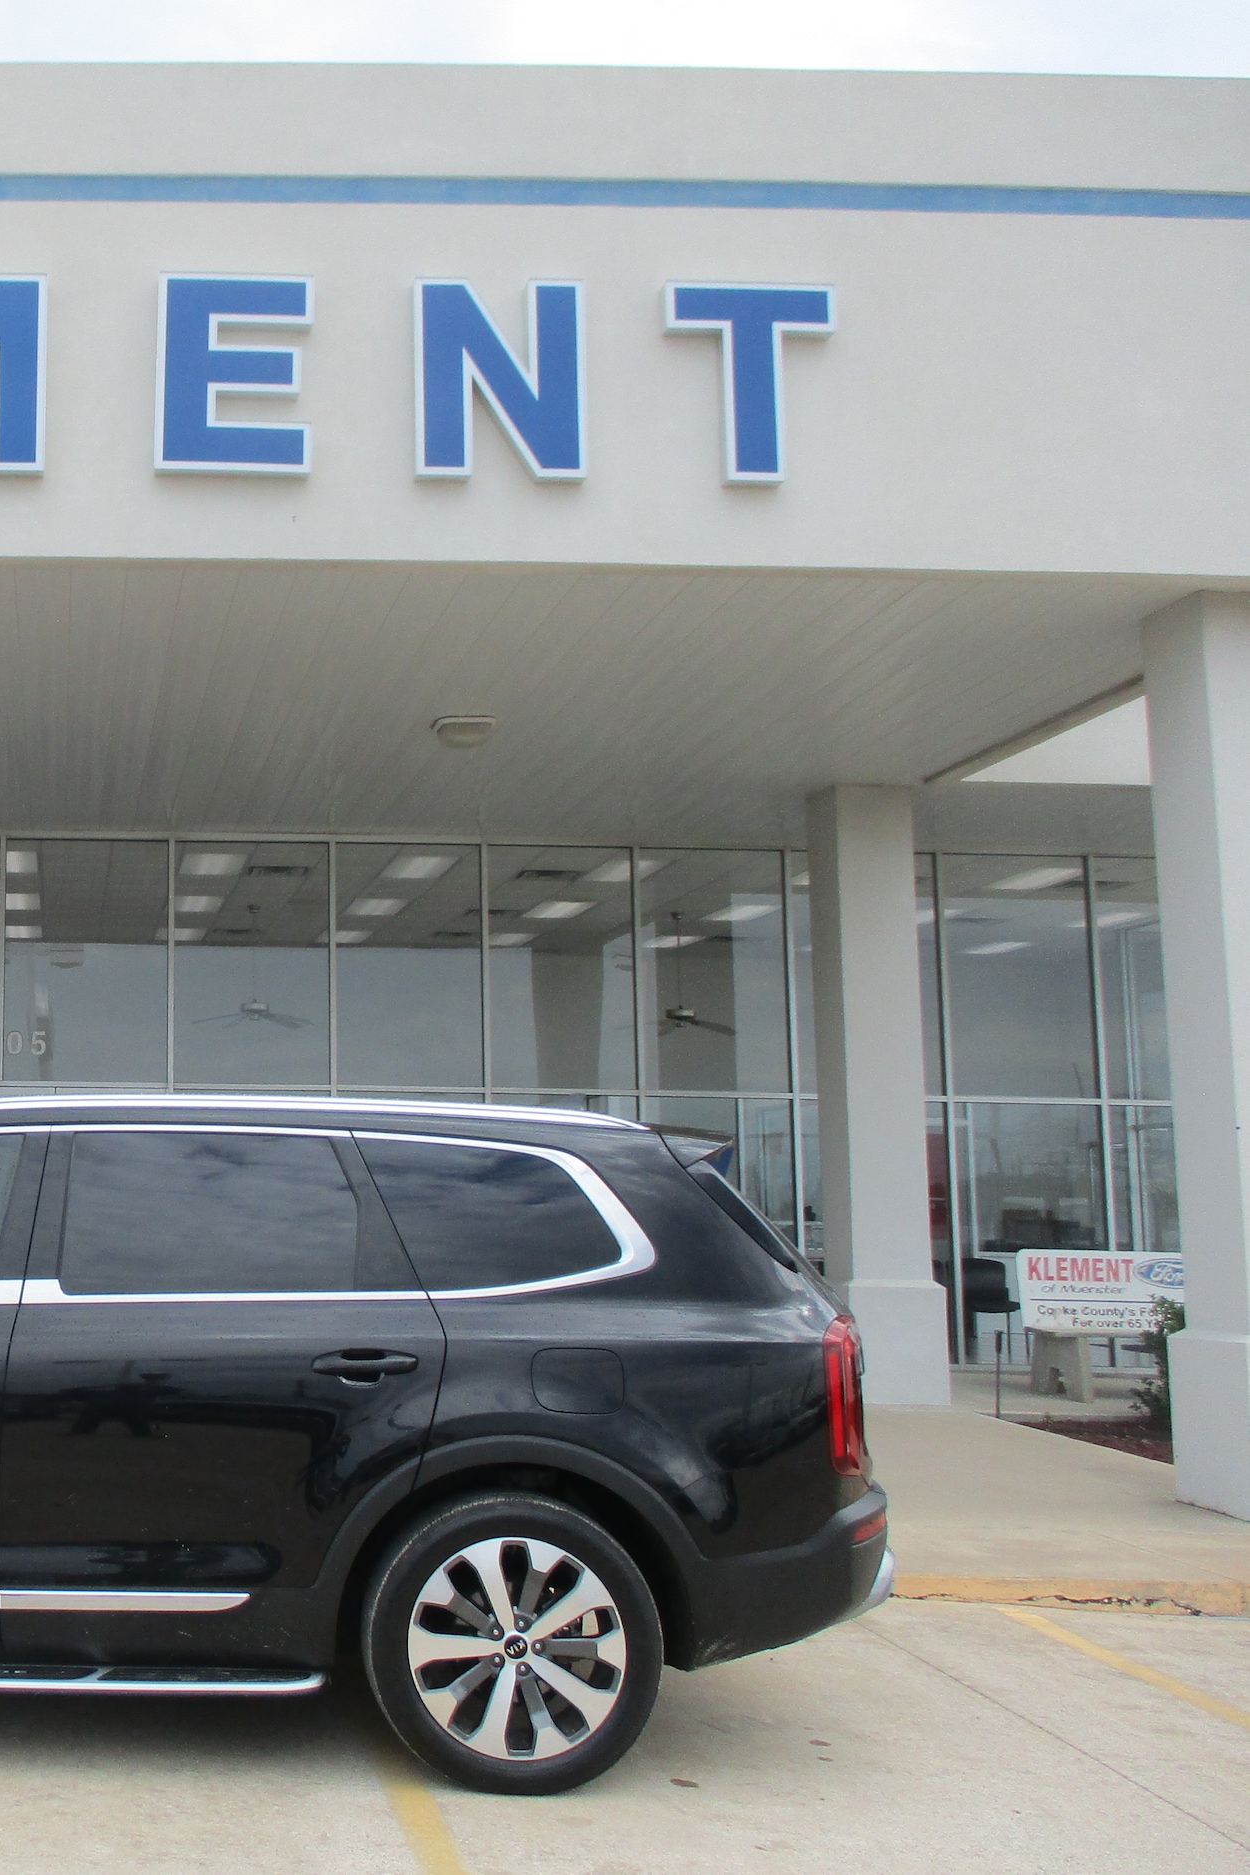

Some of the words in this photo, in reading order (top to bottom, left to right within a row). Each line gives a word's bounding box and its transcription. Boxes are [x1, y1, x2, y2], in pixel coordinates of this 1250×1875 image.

[1027, 1257, 1134, 1283] KLEMENT
[1150, 1262, 1182, 1285] For
[1041, 1284, 1056, 1293] of
[1060, 1285, 1126, 1294] Muenster
[1037, 1304, 1078, 1316] Coke
[1081, 1306, 1136, 1319] County's
[1072, 1317, 1093, 1328] For
[1096, 1319, 1124, 1329] over
[1127, 1319, 1141, 1328] 65
[506, 1640, 526, 1655] KIA
